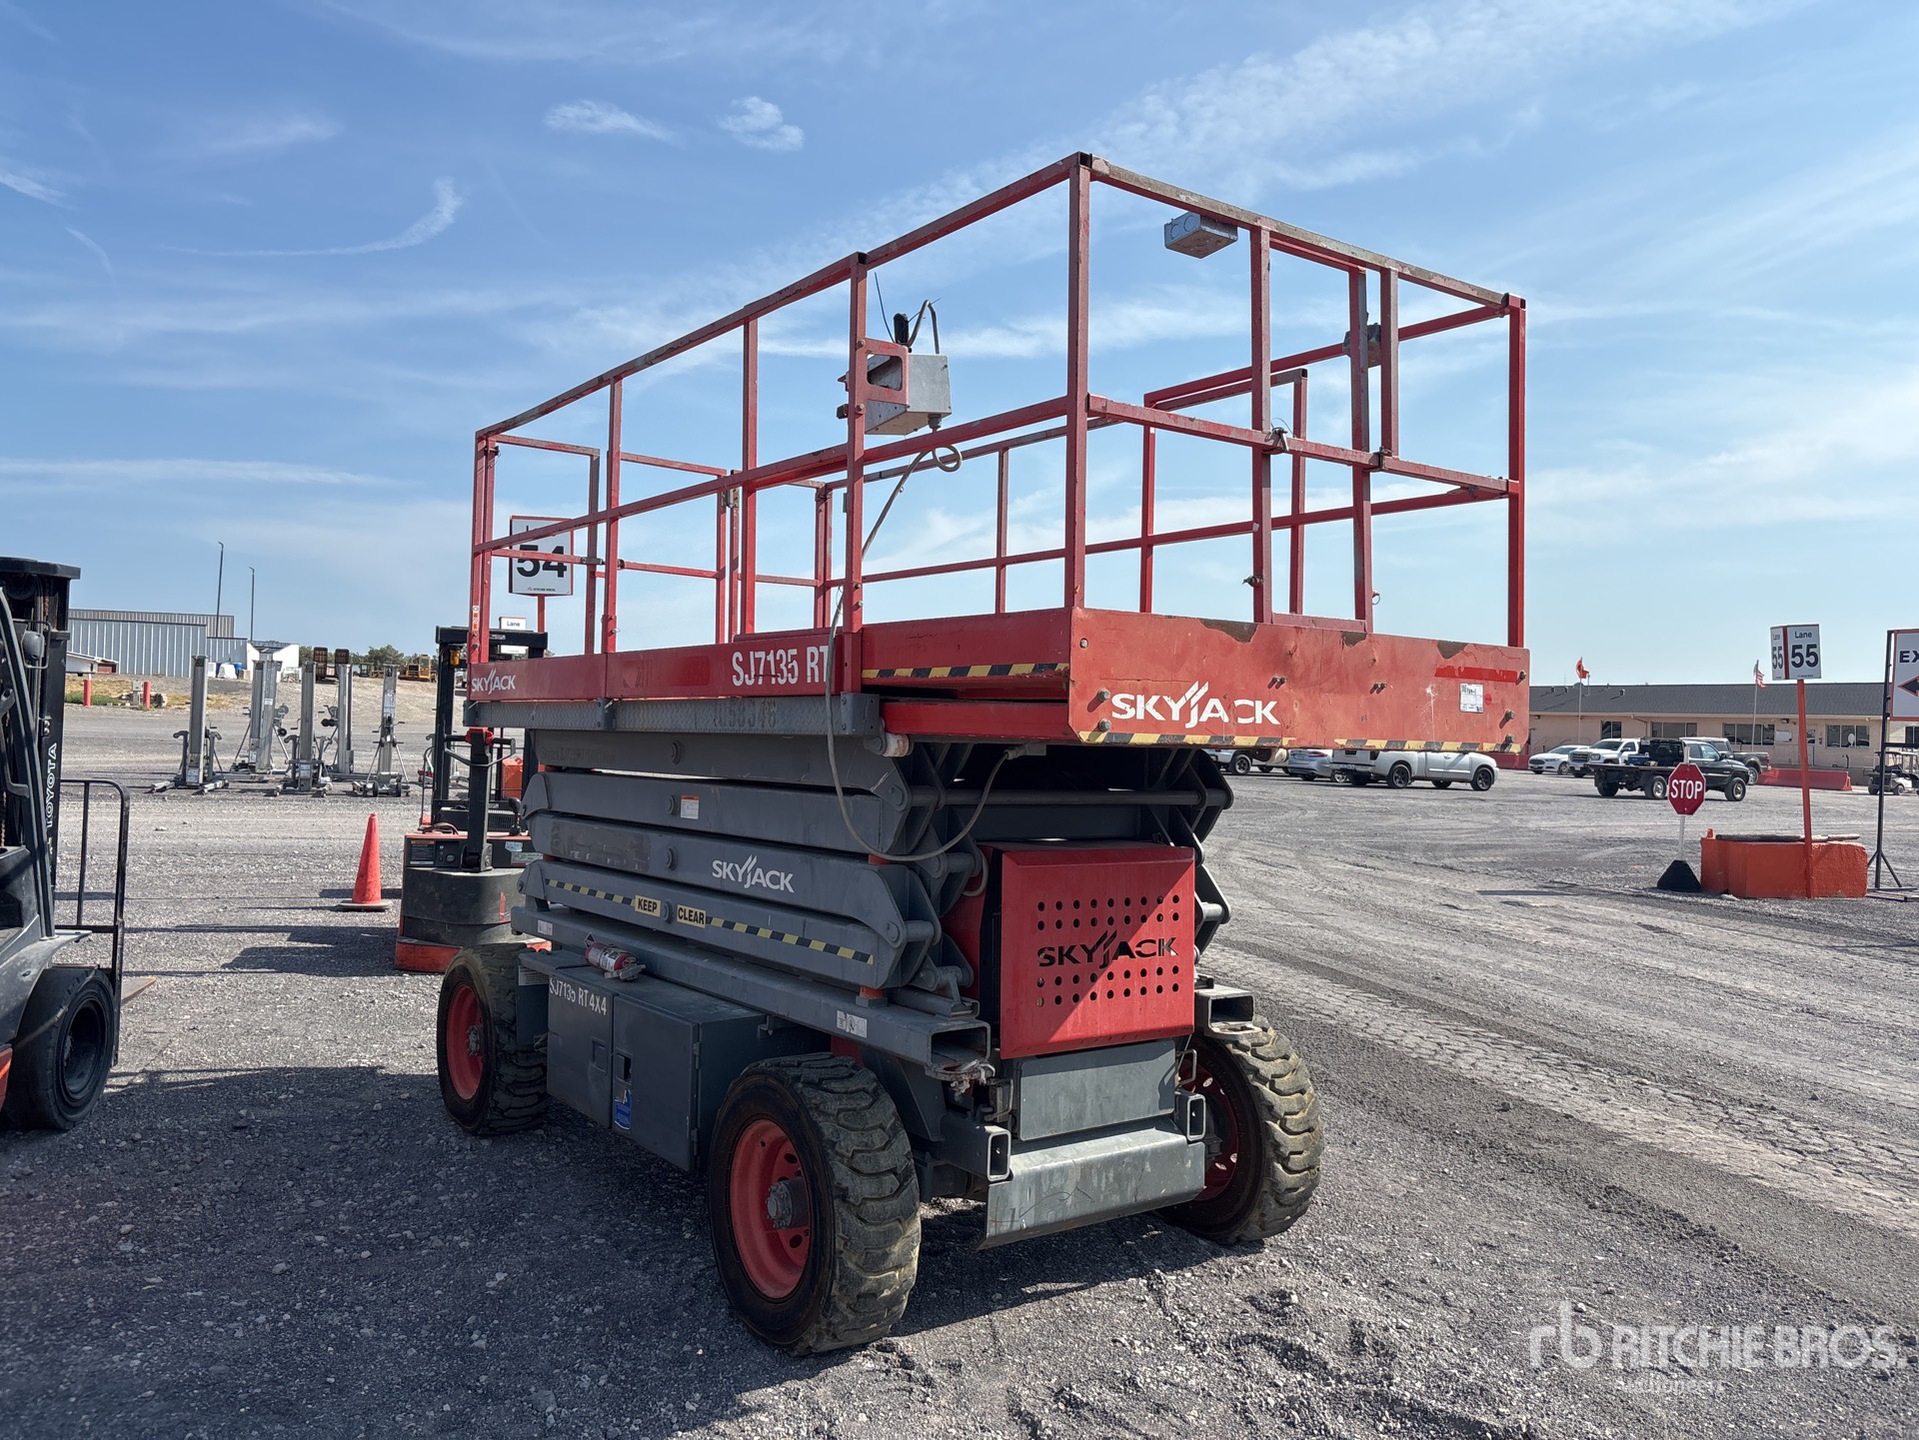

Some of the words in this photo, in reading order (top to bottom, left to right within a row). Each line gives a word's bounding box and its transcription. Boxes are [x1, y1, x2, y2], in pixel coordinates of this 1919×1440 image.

[516, 544, 567, 578] 54
[1795, 631, 1813, 639] Lane
[732, 648, 799, 686] SJ7135
[806, 645, 829, 683] RT
[1772, 646, 1784, 669] 55
[1791, 644, 1819, 668] 55
[471, 668, 516, 695] SKYJACK
[1111, 680, 1281, 729] SKYJACK
[46, 742, 57, 828] TOYOTA
[1671, 779, 1703, 799] STOP
[712, 854, 795, 893] SKYJACK
[637, 898, 658, 913] KEEP
[677, 907, 705, 925] CLEAR
[1037, 930, 1178, 969] SKYJACK
